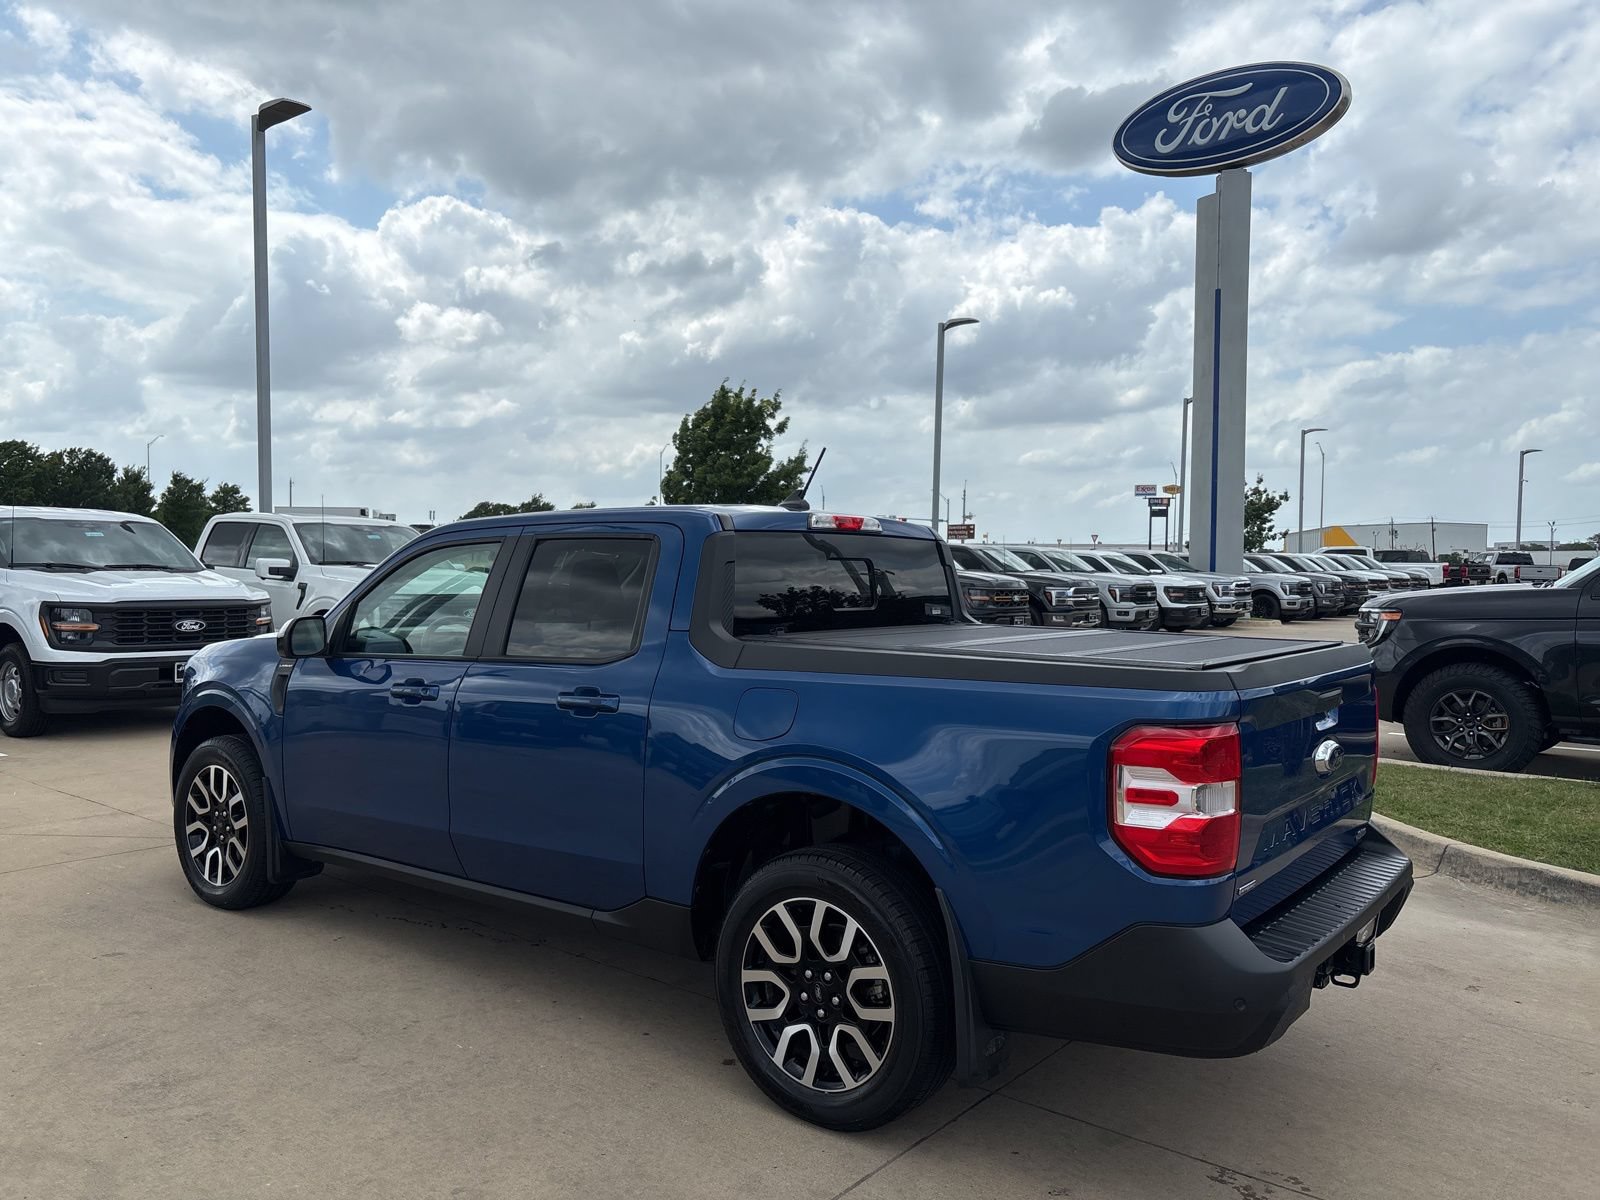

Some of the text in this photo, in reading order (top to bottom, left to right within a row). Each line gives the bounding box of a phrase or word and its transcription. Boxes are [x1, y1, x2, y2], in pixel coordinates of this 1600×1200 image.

[1154, 82, 1289, 154] Ford
[1136, 485, 1156, 493] Exxon
[181, 621, 201, 630] Ford
